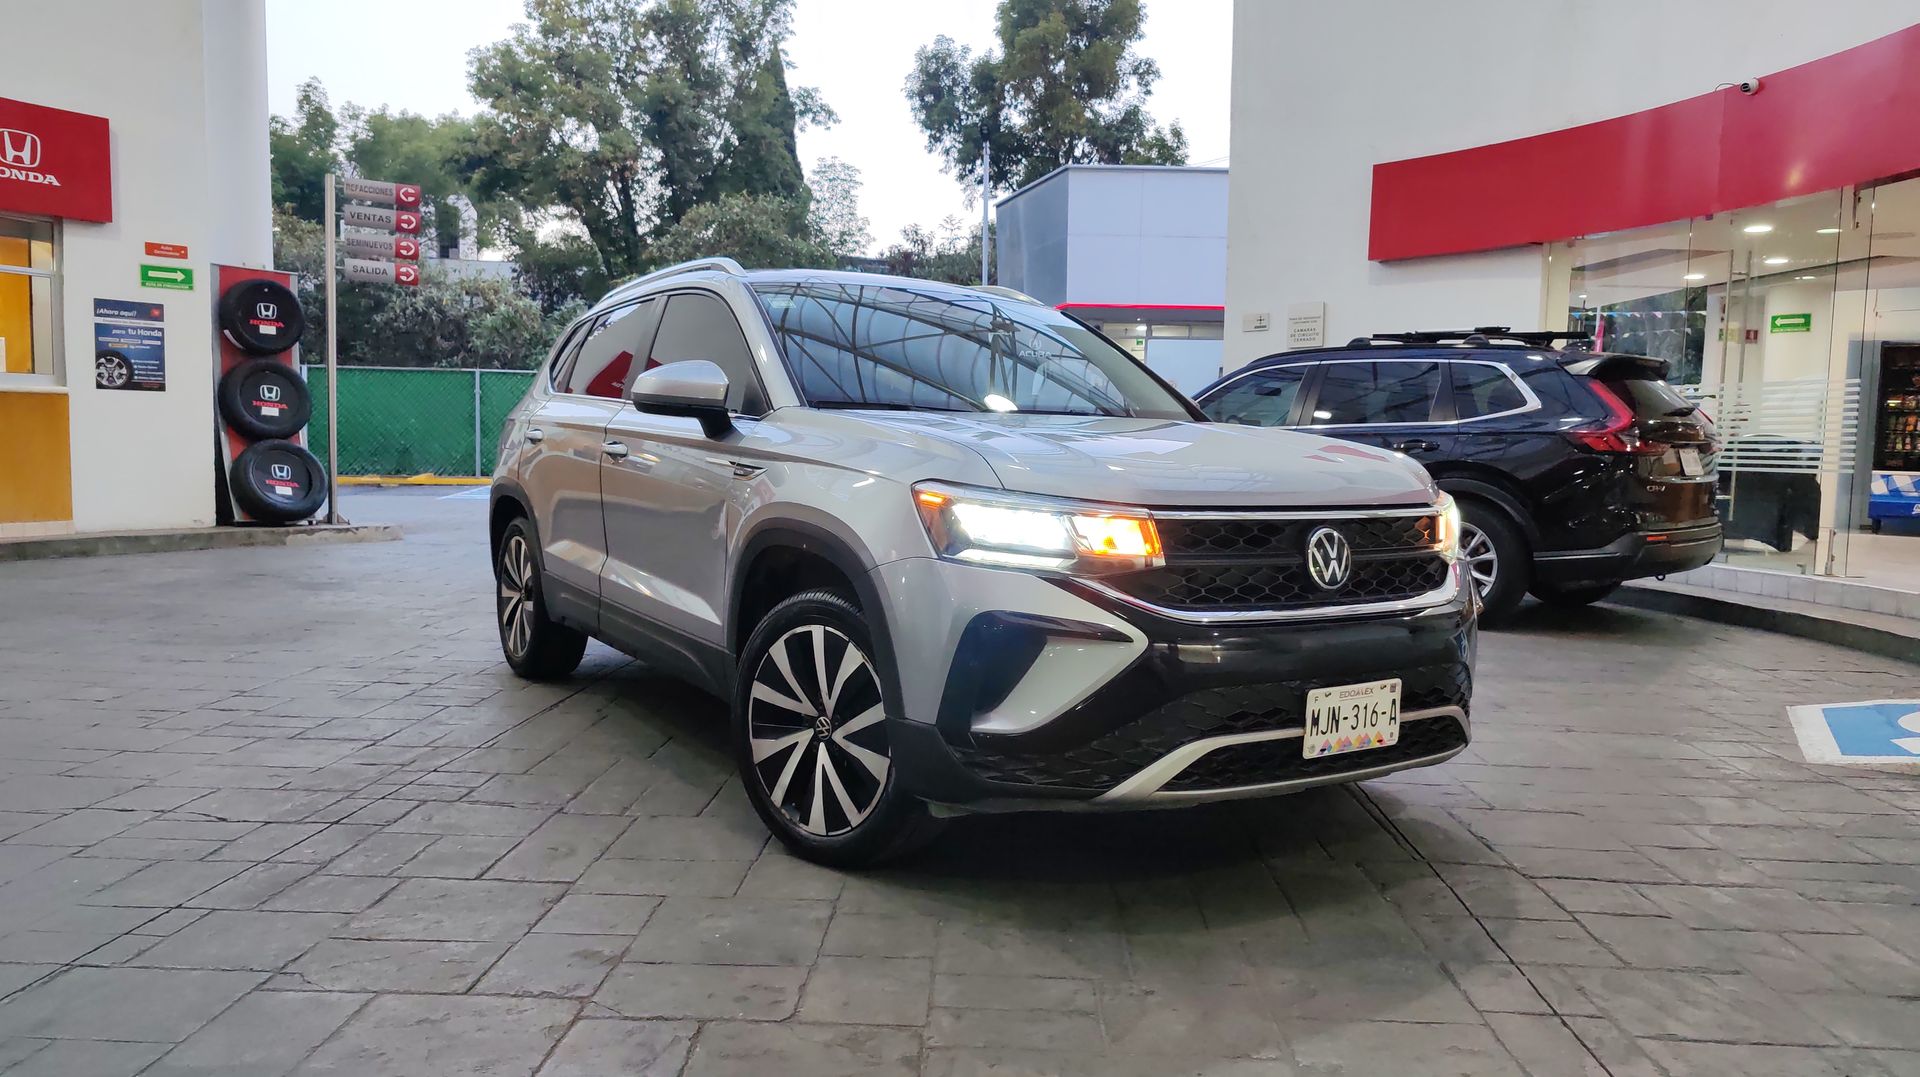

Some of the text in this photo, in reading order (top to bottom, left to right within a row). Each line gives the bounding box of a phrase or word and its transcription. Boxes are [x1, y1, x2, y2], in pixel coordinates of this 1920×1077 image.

[345, 182, 393, 198] REFACCIONES
[349, 211, 392, 224] VENTAS
[346, 237, 393, 250] SEMINUEVOS
[352, 264, 388, 276] SALIDA
[249, 319, 285, 328] HONDA
[137, 329, 163, 337] Honda
[252, 400, 289, 409] HONDA
[265, 479, 301, 488] HONDA
[1310, 698, 1397, 737] MJN-316-A
